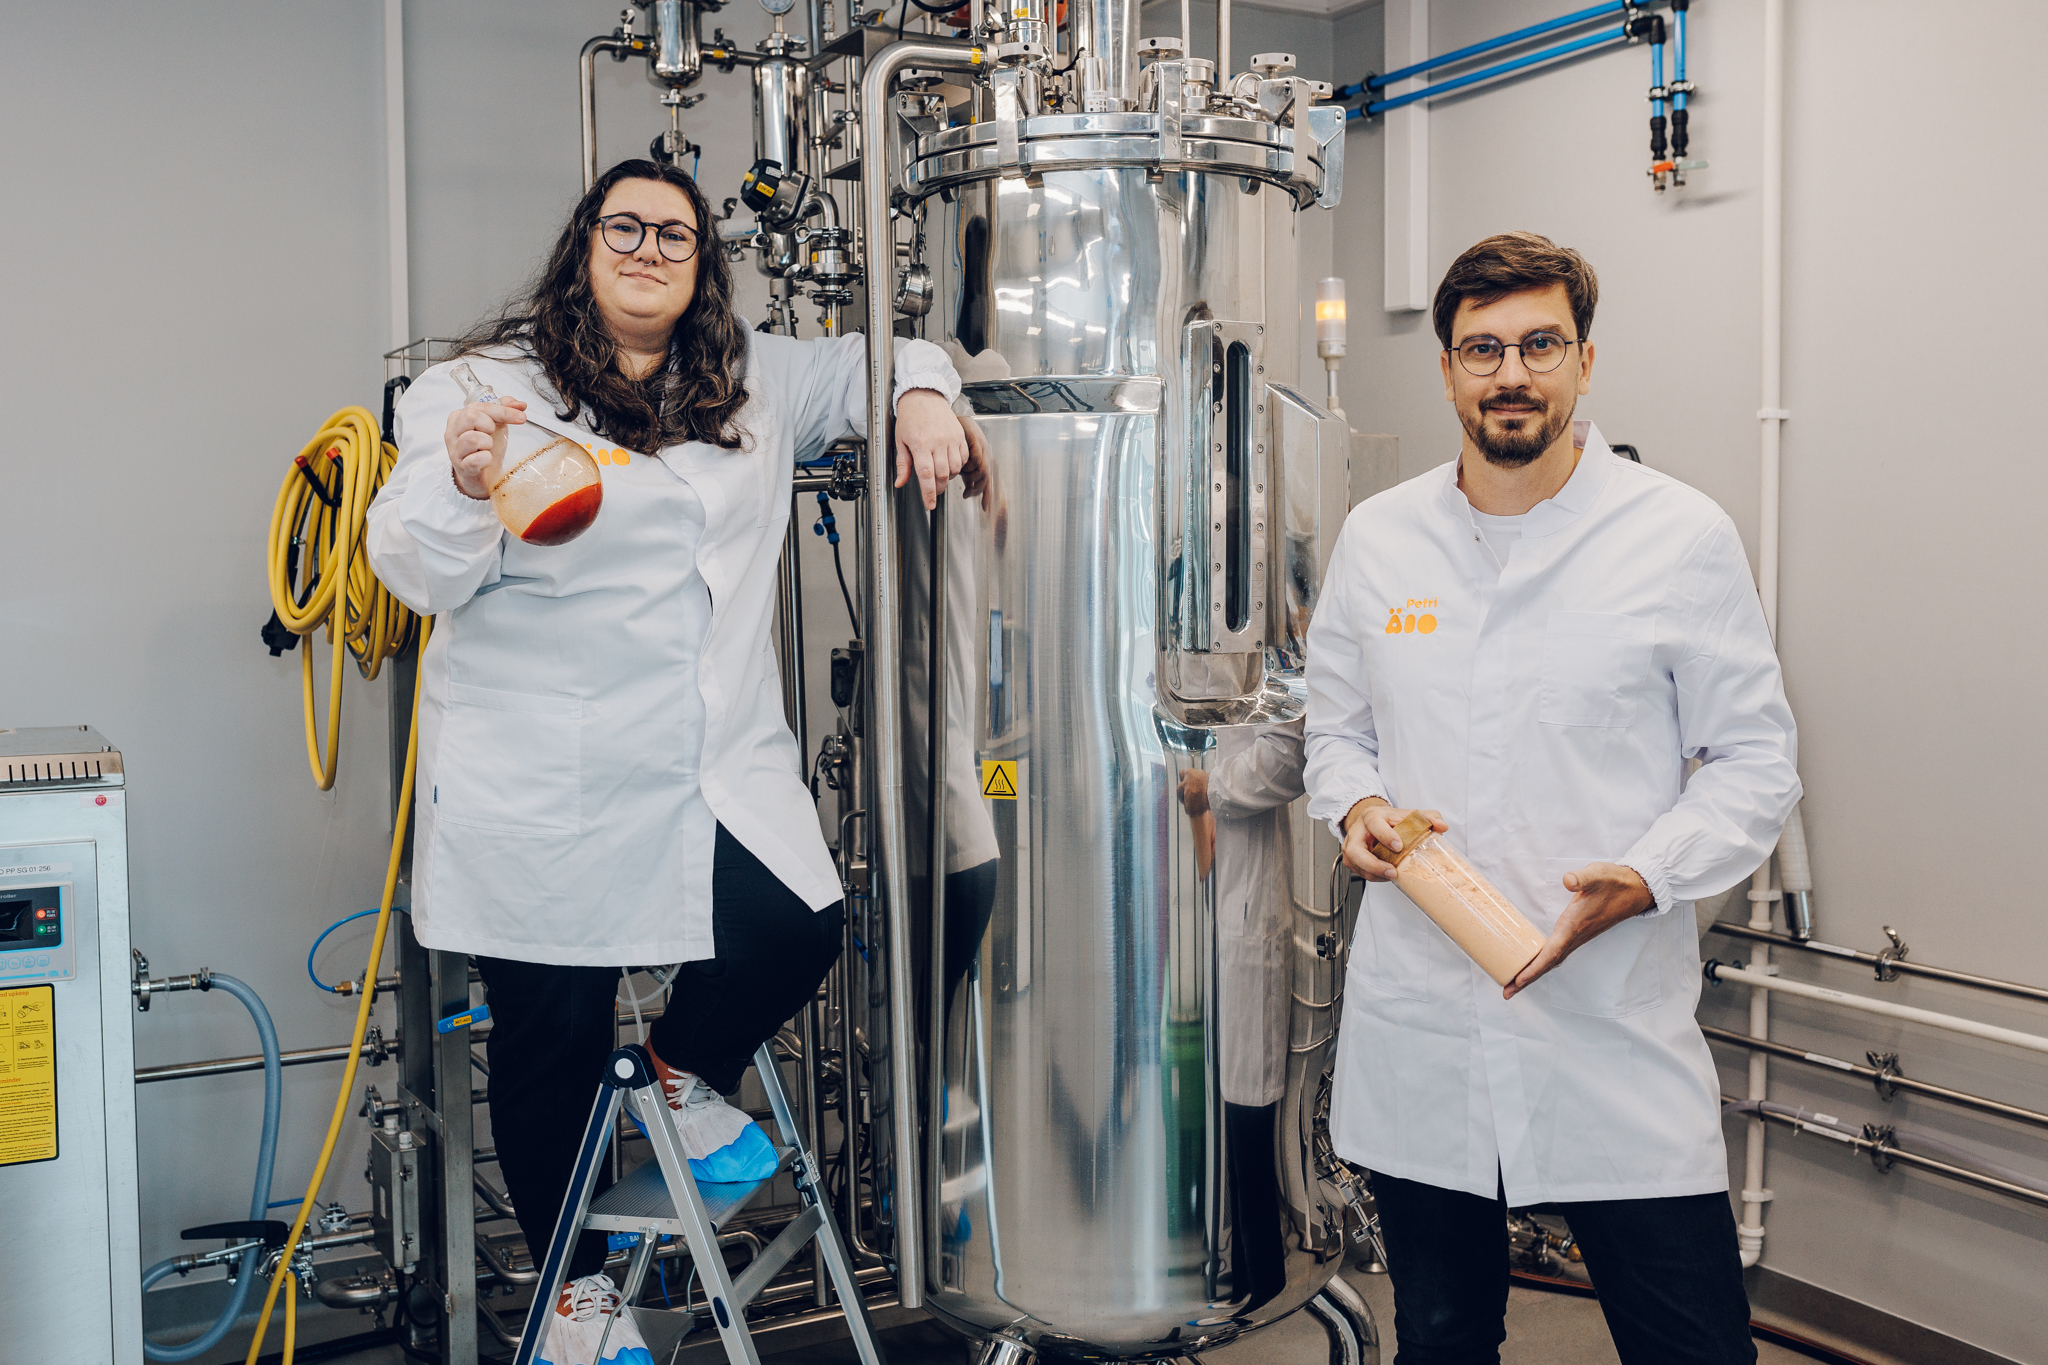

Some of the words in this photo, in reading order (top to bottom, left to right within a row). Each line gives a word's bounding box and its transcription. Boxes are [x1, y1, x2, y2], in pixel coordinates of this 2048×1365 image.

[578, 443, 631, 466] IO
[1406, 597, 1438, 609] Petri
[1385, 607, 1438, 635] ÄIO
[8, 990, 30, 998] upkeep
